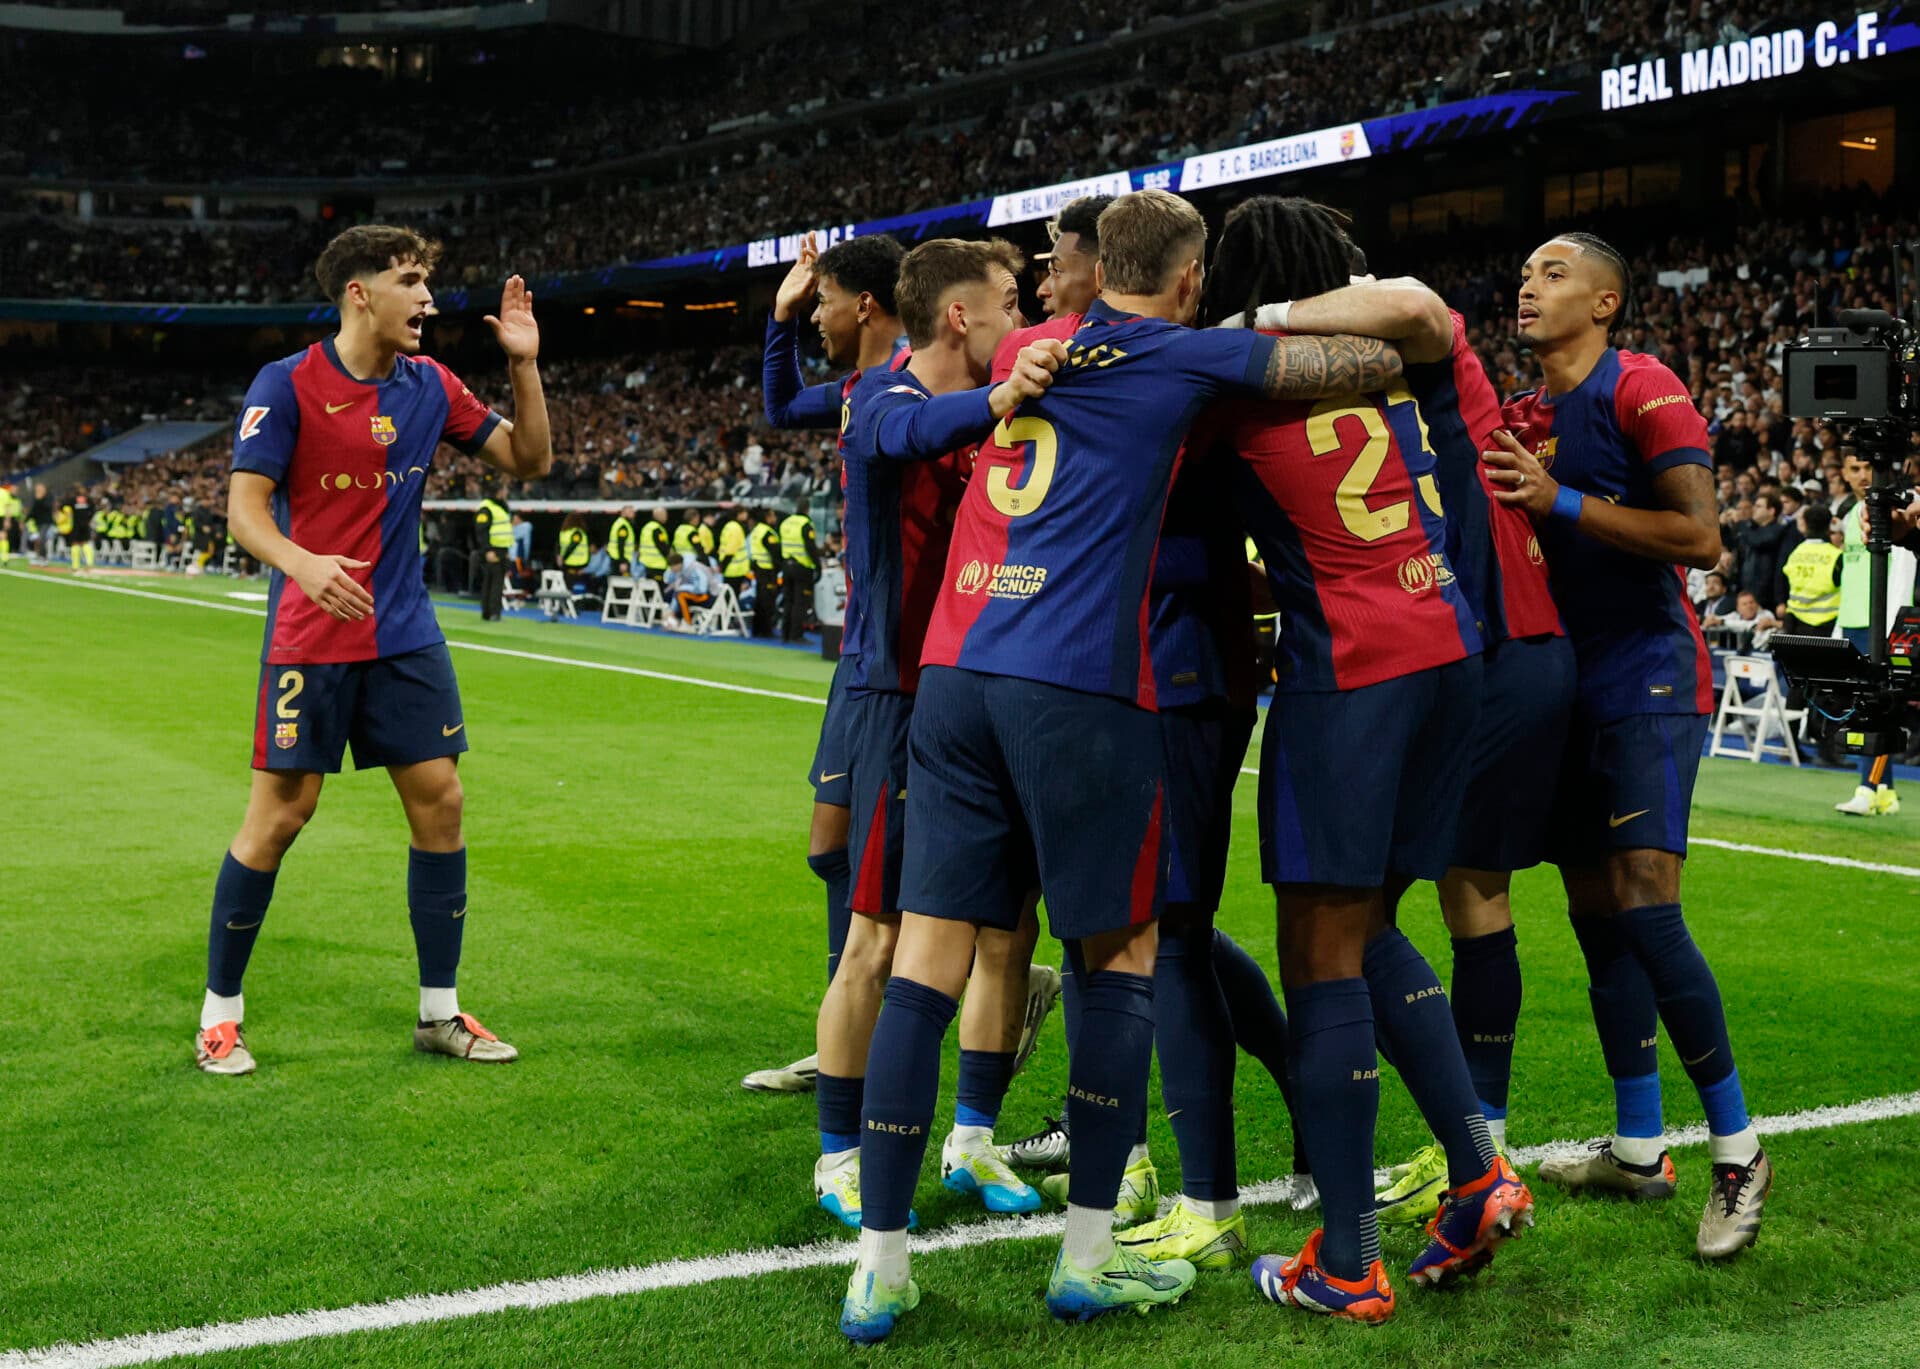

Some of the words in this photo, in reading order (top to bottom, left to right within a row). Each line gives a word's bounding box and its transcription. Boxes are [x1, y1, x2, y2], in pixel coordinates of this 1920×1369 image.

[1601, 58, 1673, 111] REAL
[1681, 29, 1804, 95] MADRID
[1815, 21, 1850, 68] C.
[1857, 12, 1887, 60] F.
[1195, 162, 1203, 183] 2
[1249, 140, 1318, 172] BARCELONA
[747, 239, 778, 268] REAL
[1637, 394, 1687, 417] AMBILIGHT
[986, 415, 1058, 517] 5
[986, 578, 1043, 594] ACNUR
[992, 563, 1048, 582] UNHCR
[276, 670, 305, 719] 2
